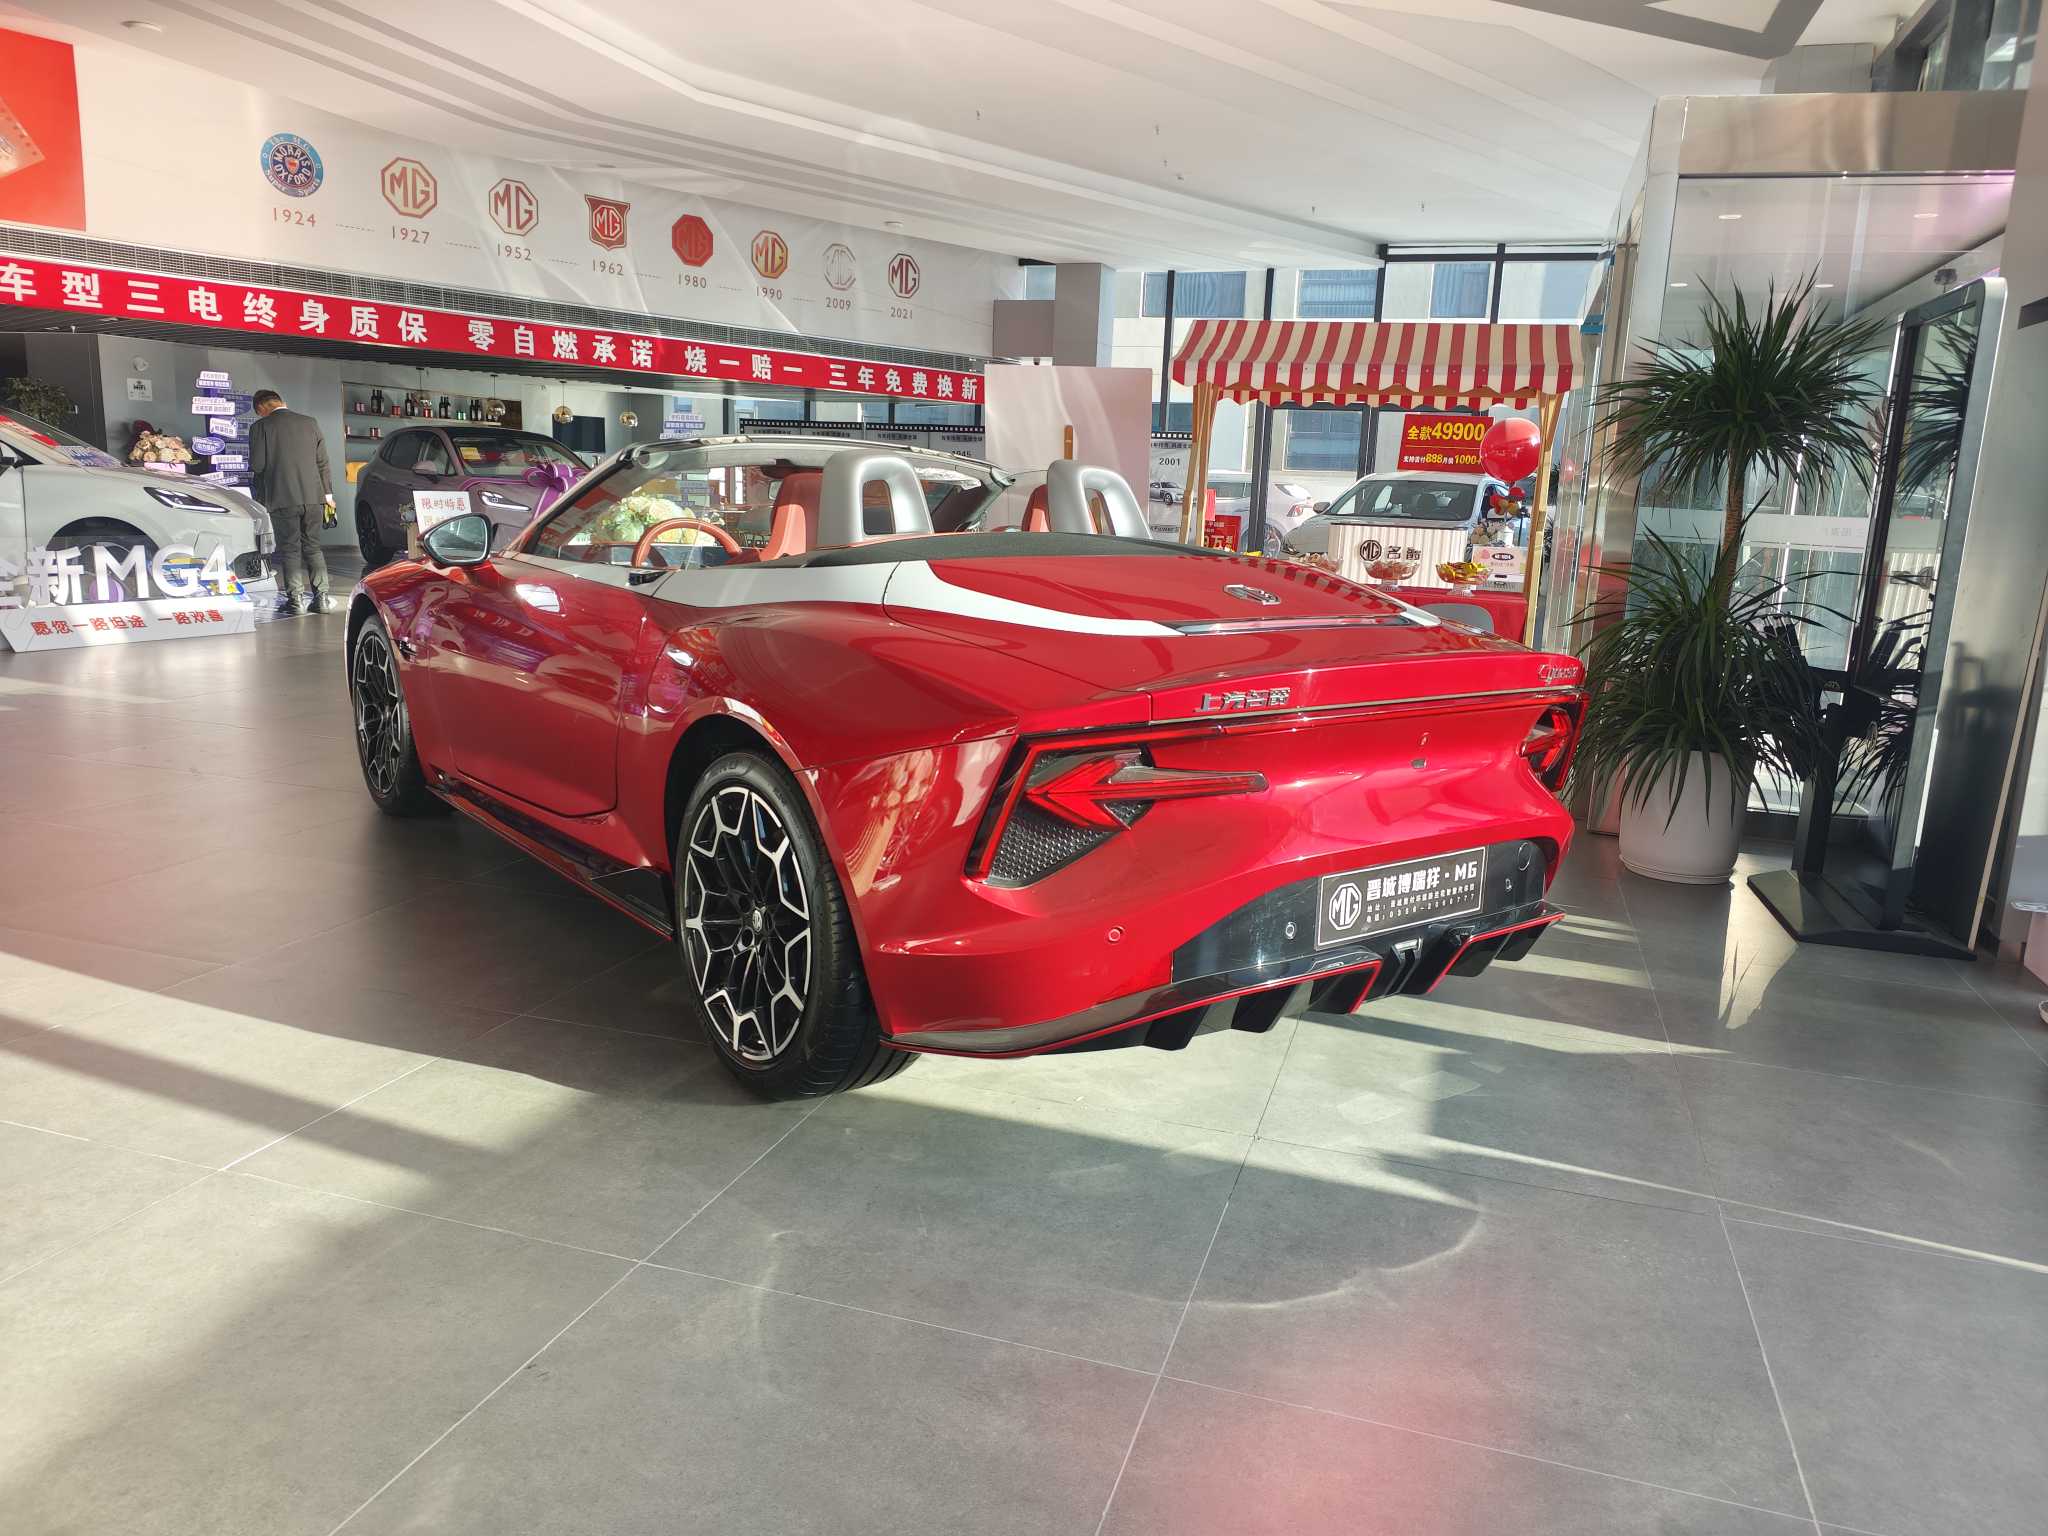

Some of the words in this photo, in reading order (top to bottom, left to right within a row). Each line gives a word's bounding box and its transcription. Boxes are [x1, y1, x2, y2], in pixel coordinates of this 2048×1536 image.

[274, 144, 311, 167] MORRIS
[274, 163, 311, 185] OXFORD
[388, 164, 432, 211] MG
[492, 181, 535, 232] MG
[272, 207, 317, 228] 1924
[593, 207, 623, 240] MG
[391, 225, 431, 245] 1927
[676, 218, 709, 260] MG
[497, 243, 532, 261] 1952
[754, 234, 787, 275] MG
[592, 259, 625, 277] 1962
[889, 256, 918, 295] MG
[678, 274, 708, 289] 1980
[755, 286, 783, 301] 1990
[826, 296, 851, 311] 2009
[890, 306, 913, 320] 2021
[0, 263, 429, 344] 车型三电终身质保
[467, 318, 655, 370] 零自燃承诺
[684, 347, 803, 381] 烧一赔一
[828, 364, 979, 402] 三年免费换新
[1407, 422, 1485, 441] 全款49900
[1159, 457, 1181, 467] 2001
[421, 496, 465, 511] 限时特惠
[1361, 541, 1381, 560] MG
[1387, 546, 1422, 561] 名爵
[31, 614, 147, 637] 愿您一路坦途
[158, 609, 225, 626] 一路欢喜
[1194, 686, 1292, 713] 上汽名爵
[1330, 886, 1361, 928] MG
